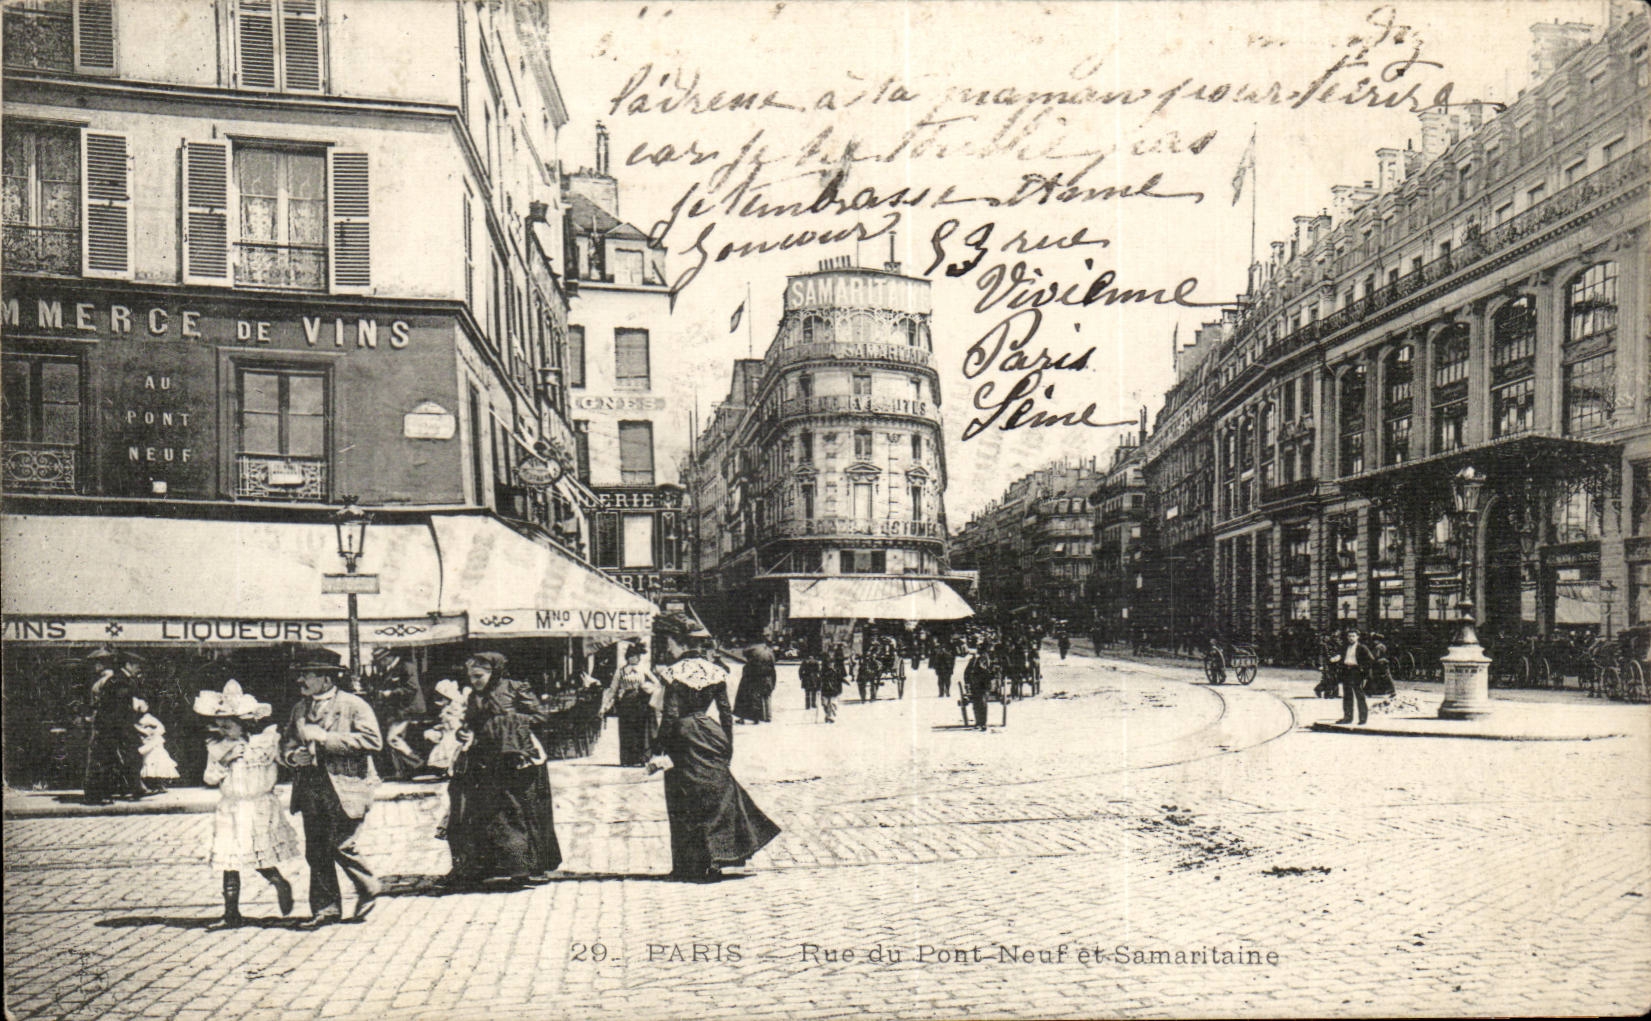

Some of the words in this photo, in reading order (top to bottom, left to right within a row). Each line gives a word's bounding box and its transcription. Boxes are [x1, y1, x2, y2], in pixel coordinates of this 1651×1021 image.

[1000, 227, 1110, 254] rue
[237, 320, 271, 343] DE
[303, 316, 411, 350] VINS
[962, 308, 1097, 379] Paris
[144, 375, 171, 390] AU
[961, 369, 1138, 441] Seine
[127, 411, 191, 427] PONT
[129, 446, 192, 463] NEUF
[162, 620, 325, 641] LIQUEURS
[579, 611, 651, 630] VOYETTE
